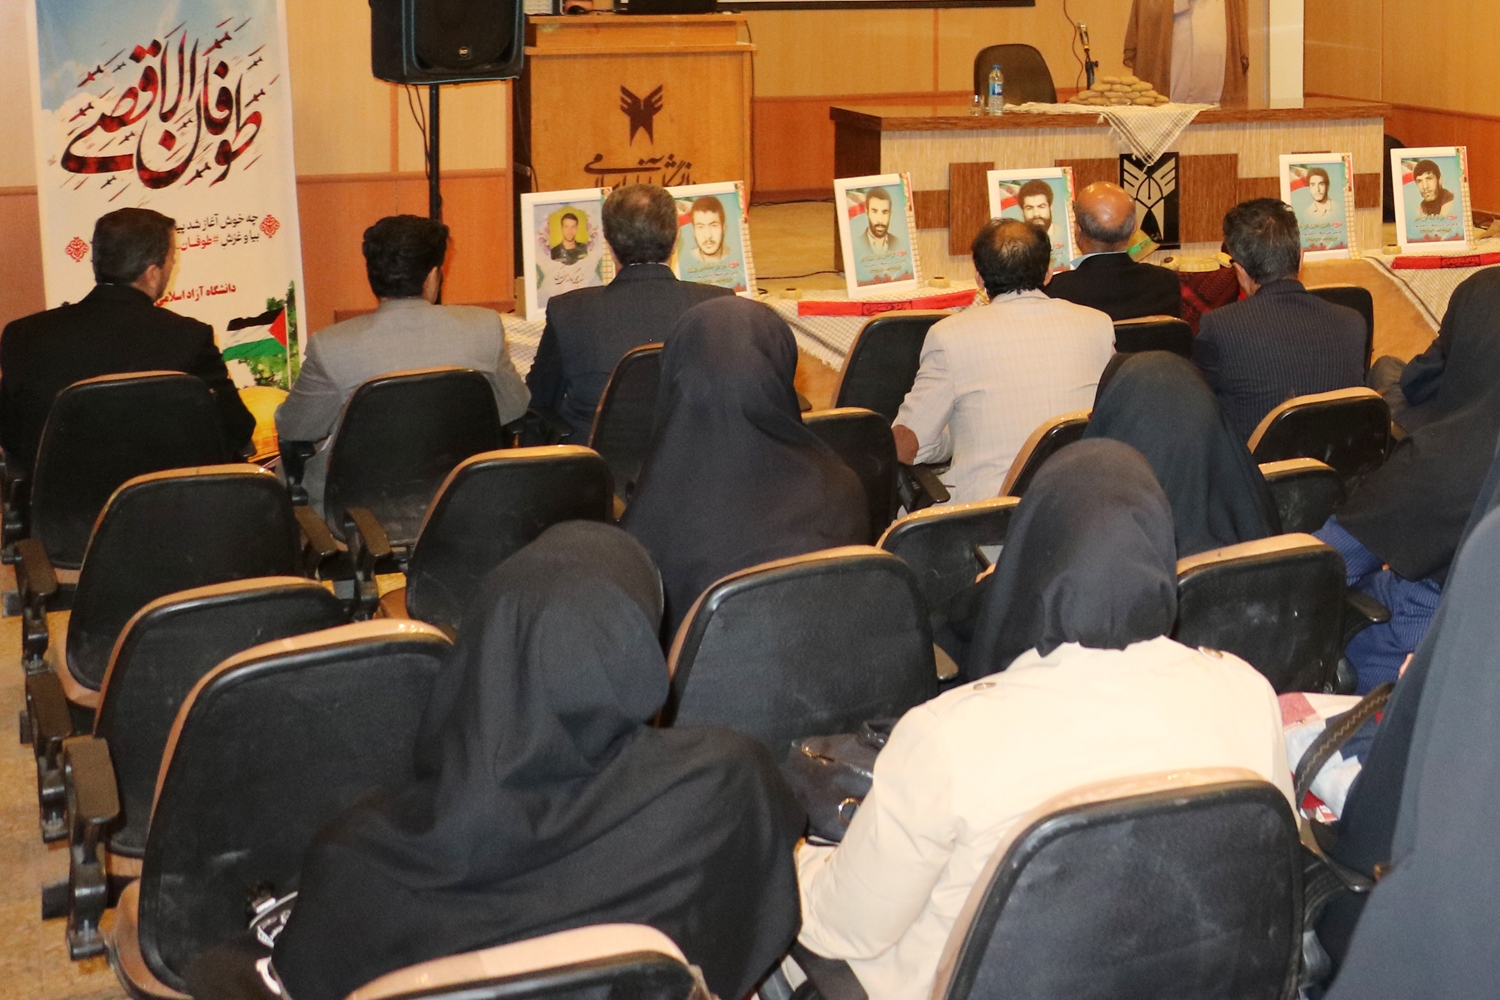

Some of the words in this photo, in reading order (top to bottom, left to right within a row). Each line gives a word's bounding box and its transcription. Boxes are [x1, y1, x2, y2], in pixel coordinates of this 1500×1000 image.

[136, 56, 262, 189] طوفان
[187, 219, 201, 230] شد
[202, 213, 219, 231] آغاز
[220, 213, 244, 229] خوش
[246, 215, 258, 226] چه
[244, 234, 248, 244] و
[250, 230, 259, 242] بیا
[187, 285, 204, 301] آزاد
[206, 283, 236, 296] دانشگاه
[154, 290, 185, 307] اسلامی
